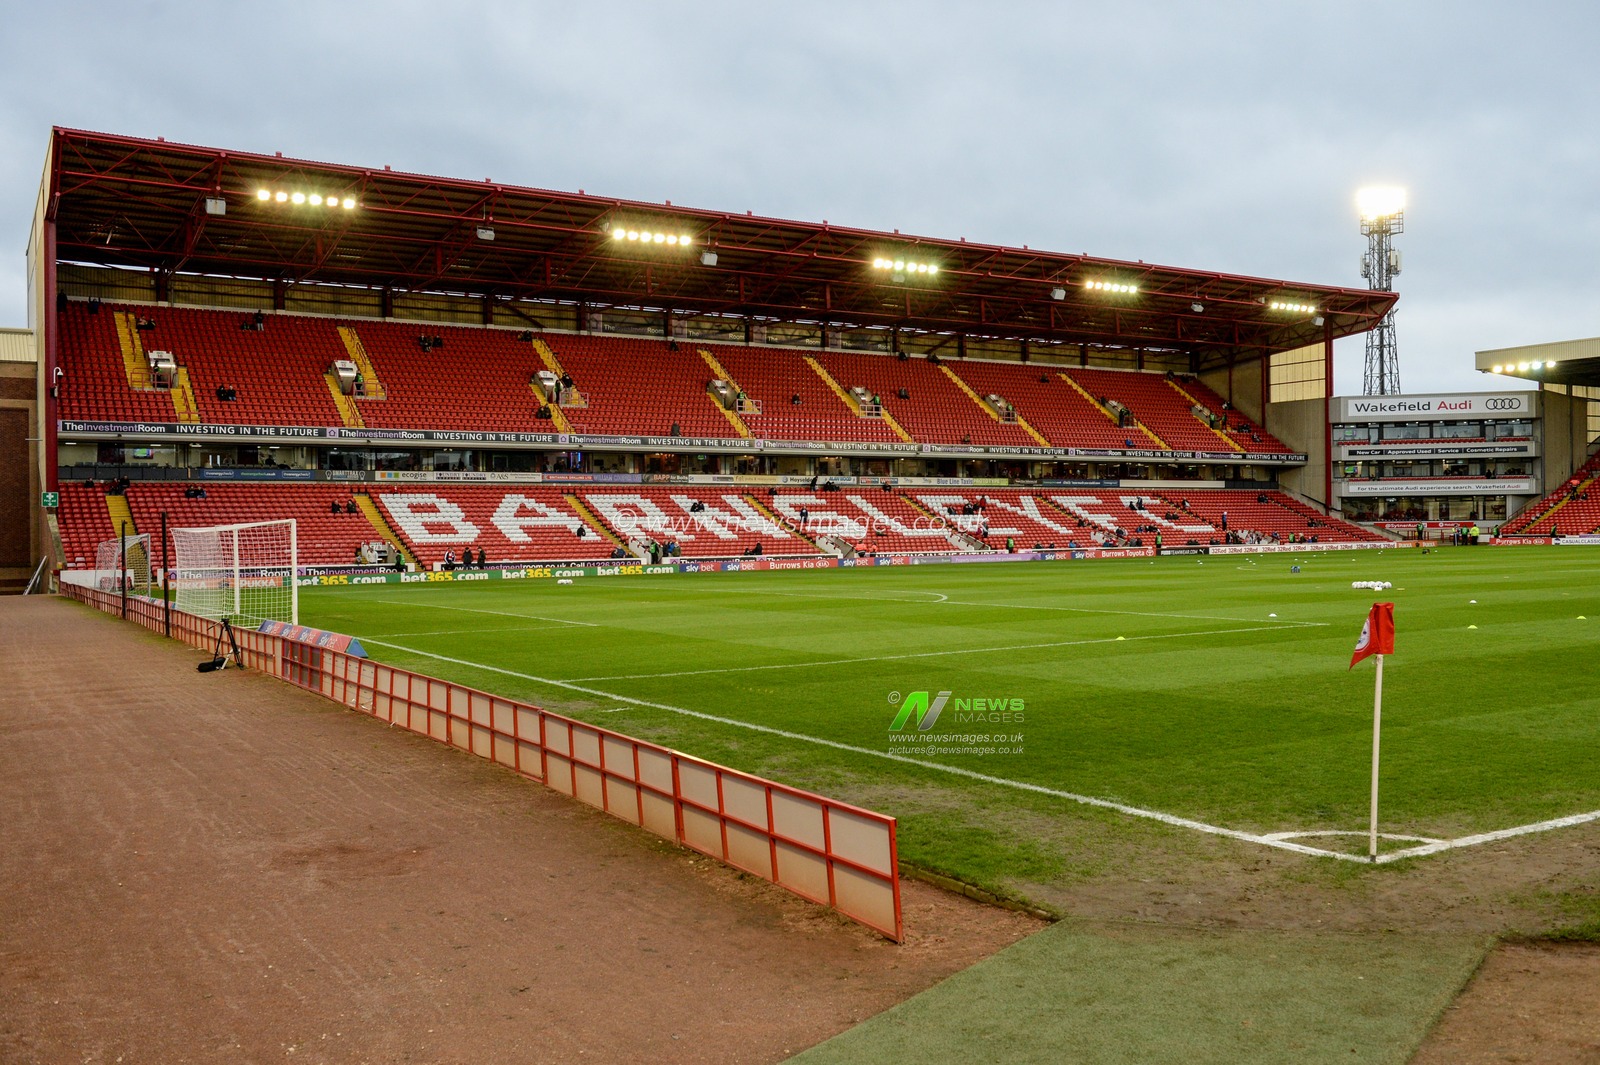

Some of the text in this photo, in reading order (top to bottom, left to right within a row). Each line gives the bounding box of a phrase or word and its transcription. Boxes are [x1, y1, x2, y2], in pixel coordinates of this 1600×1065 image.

[1354, 400, 1472, 413] Wakefield Audi
[65, 422, 319, 436] TheInvestmentRoom INVESTING IN THE FUTURE
[340, 429, 552, 443] TheInvestmentRoom INVESTING IN THE FUTURE
[648, 438, 690, 446] INVESTING
[722, 439, 750, 447] FUTURE
[686, 563, 714, 572] sky bet
[727, 563, 740, 571] sky
[879, 558, 890, 566] sky
[502, 568, 585, 579] bet365.com
[597, 565, 674, 576] bet365.com
[401, 572, 489, 583] bet365.com
